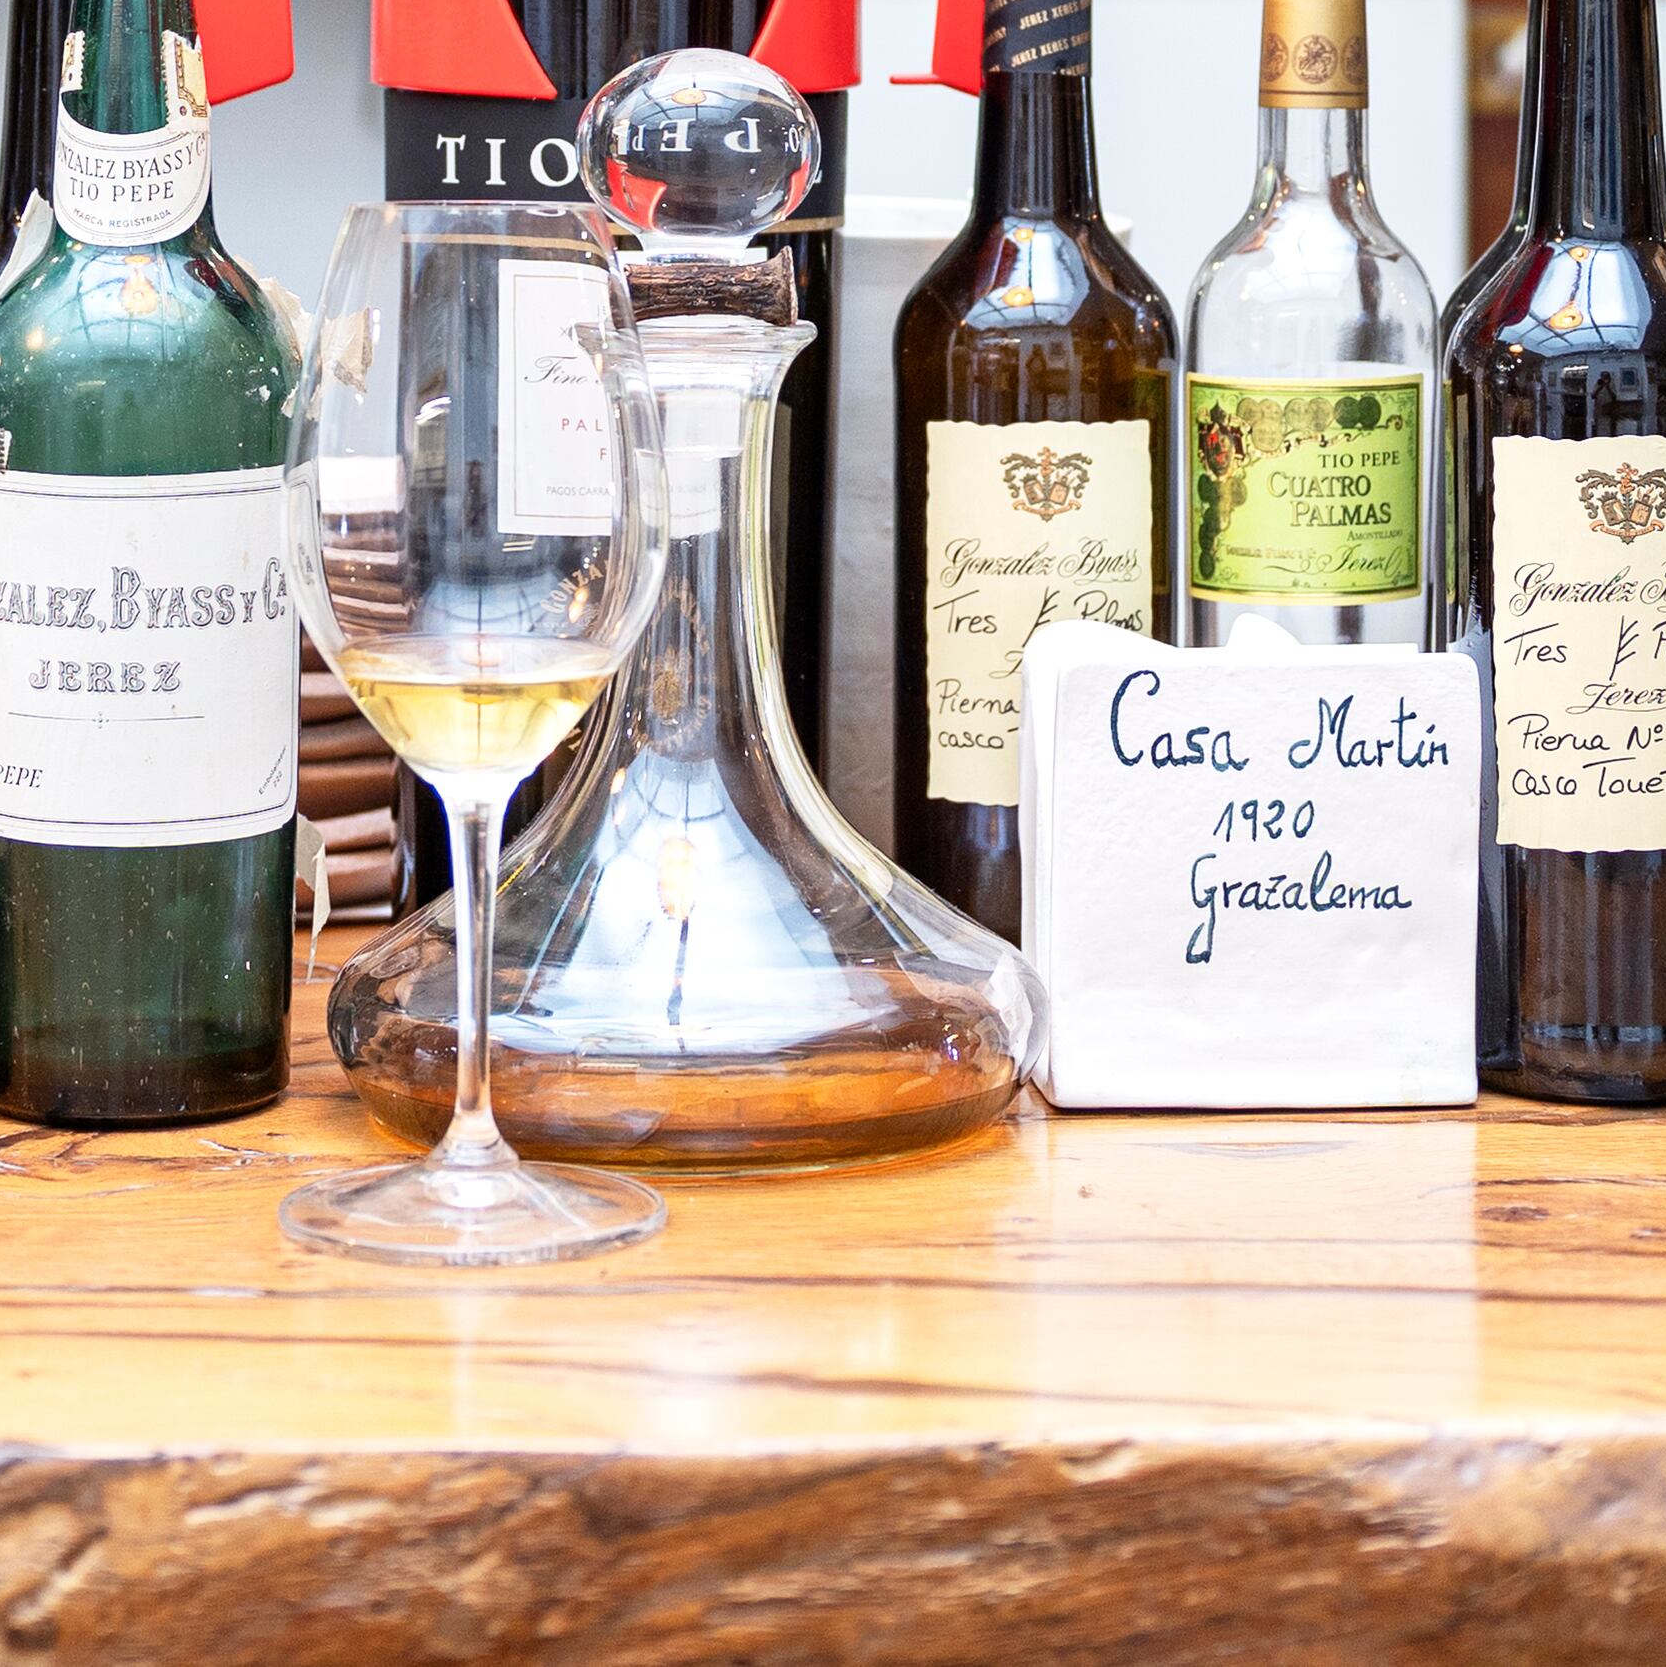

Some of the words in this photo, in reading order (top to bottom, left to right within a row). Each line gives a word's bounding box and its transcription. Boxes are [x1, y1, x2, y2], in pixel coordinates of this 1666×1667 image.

[1019, 10, 1050, 30] JEREZ
[1010, 47, 1038, 68] JEREZ
[57, 137, 116, 180] NZALEZ
[122, 149, 187, 180] BYASS
[185, 142, 194, 166] Y
[435, 132, 578, 188] TIO
[69, 177, 99, 202] TIO
[112, 180, 175, 203] PEPE
[73, 207, 104, 226] MARCA
[108, 209, 172, 228] REGISTRADA
[1318, 452, 1354, 469] TIO
[1361, 450, 1401, 467] PEPE
[545, 485, 577, 497] PAGOS
[579, 486, 612, 497] CARRA
[1268, 471, 1372, 499] CUATRO
[1289, 500, 1392, 528] PALMAS
[940, 538, 1057, 588] Gonzalez
[1058, 537, 1142, 585] Byass
[111, 565, 237, 630] BYASS
[1509, 562, 1638, 617] Gonzalez
[933, 590, 998, 635] Tres
[1504, 622, 1568, 666] Tres
[28, 659, 182, 694] JEREZ
[936, 678, 1021, 717] Pierna
[938, 730, 1006, 749] casco
[1110, 669, 1250, 772] Casa
[1213, 798, 1316, 842] 1920
[1186, 850, 1413, 965] Grazalema
